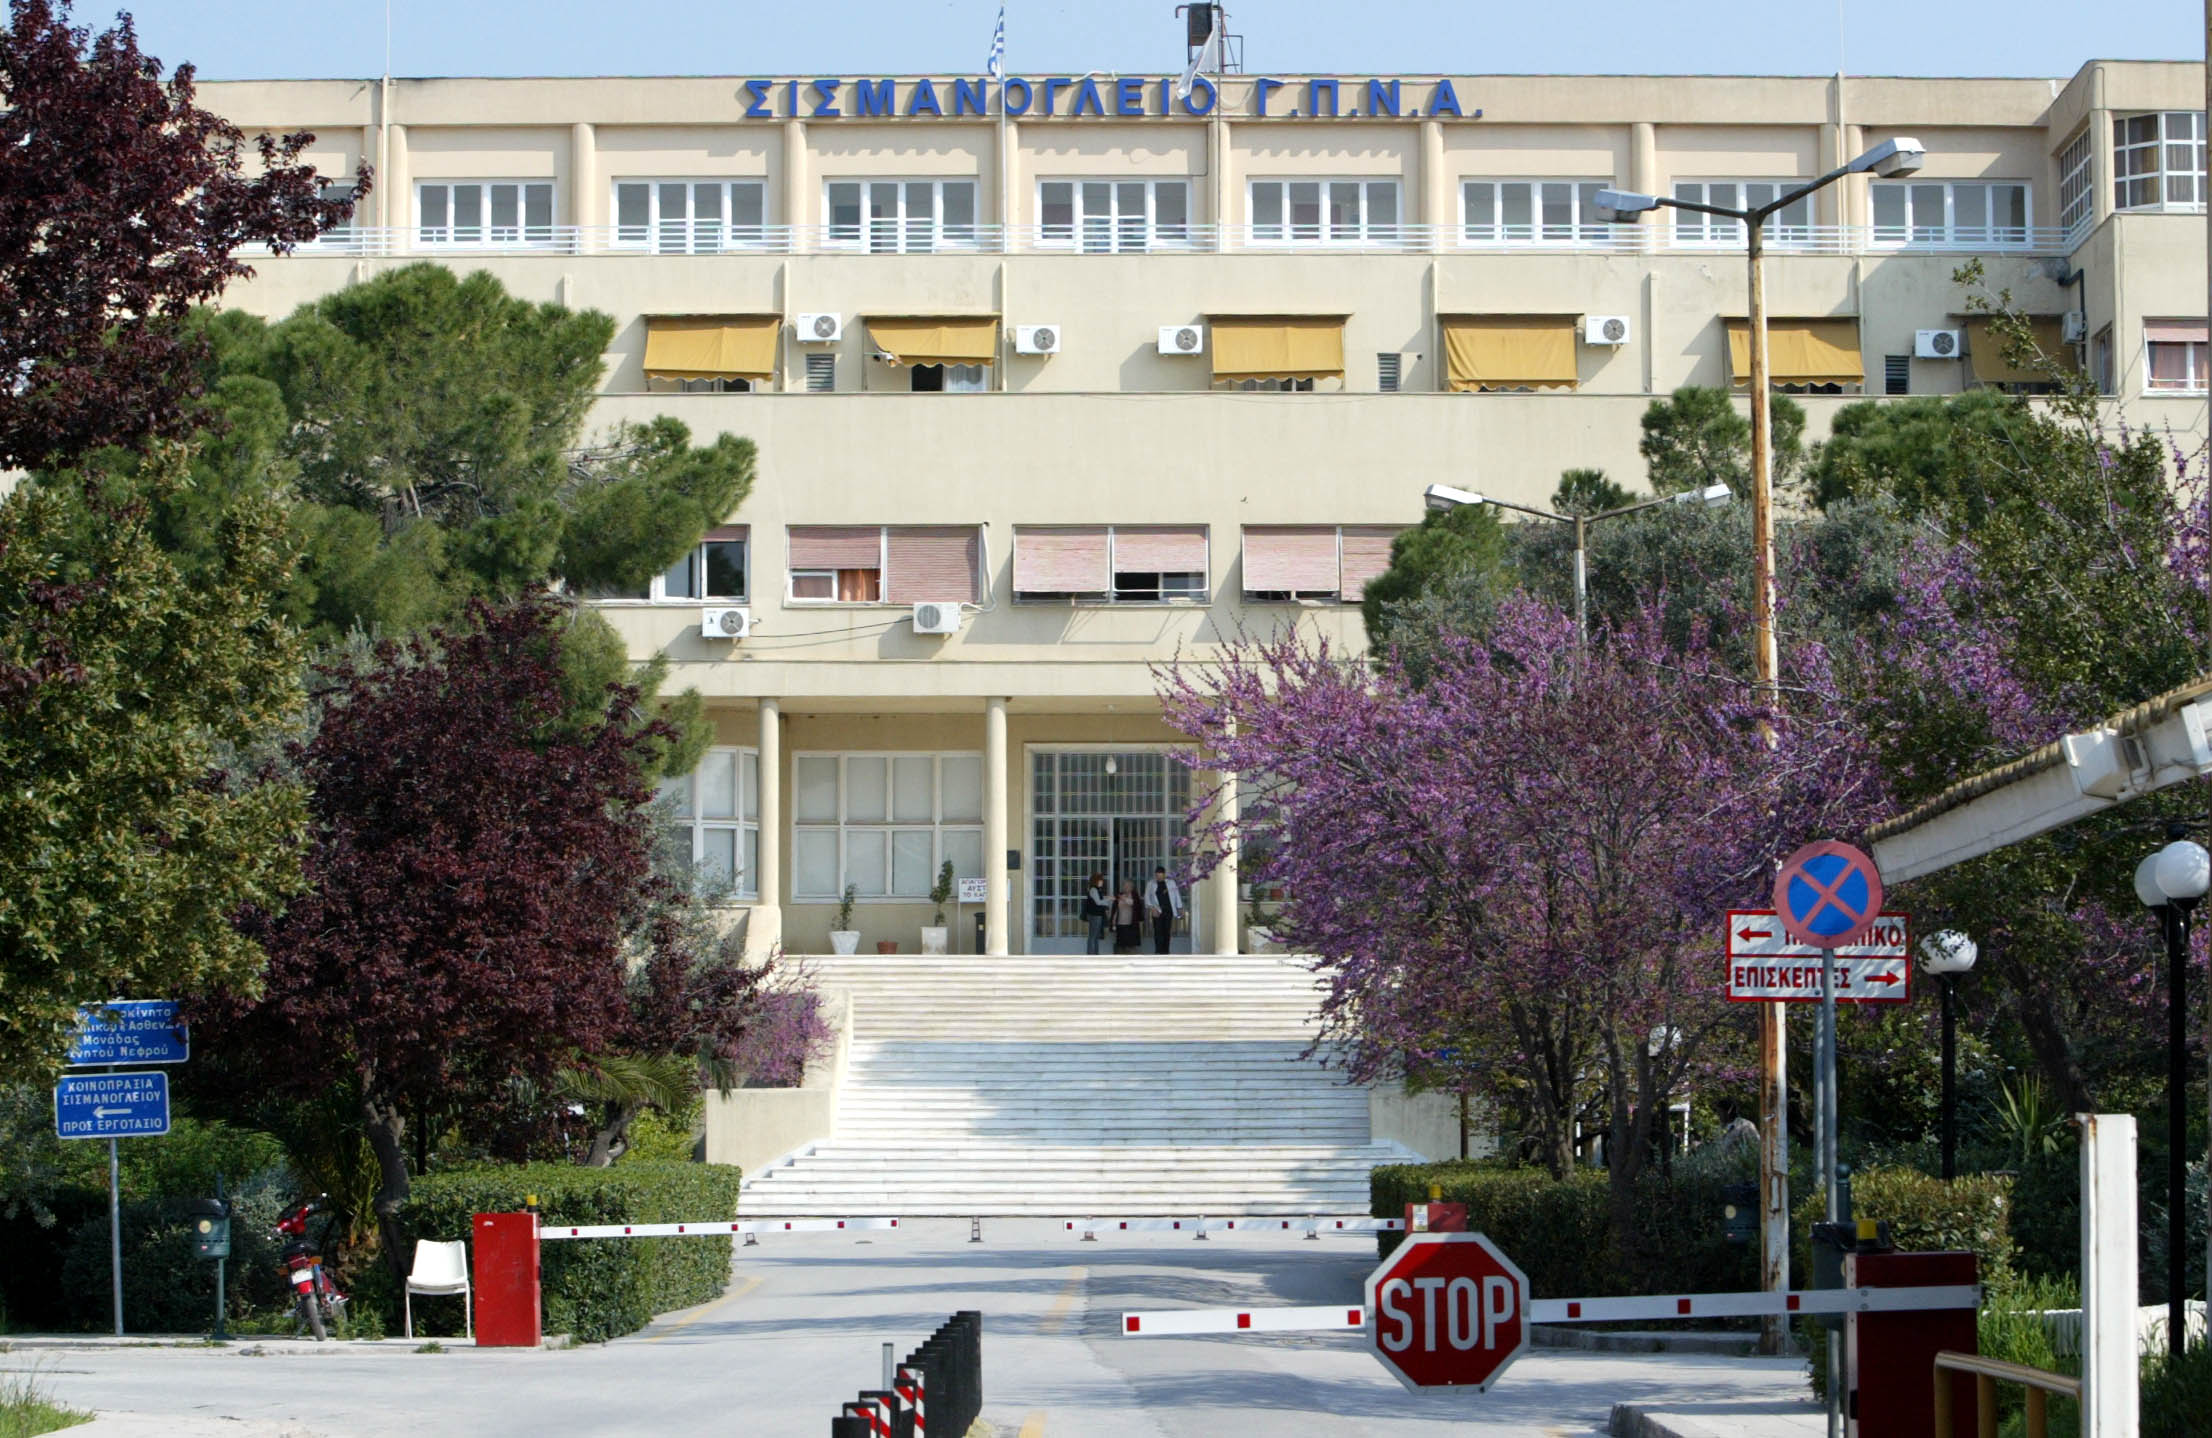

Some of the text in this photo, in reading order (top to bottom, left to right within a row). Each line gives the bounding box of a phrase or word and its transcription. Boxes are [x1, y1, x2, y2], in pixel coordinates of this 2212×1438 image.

[746, 78, 1483, 117] ΣΙΣΜΑΝΟΓΛΕΙΟ Γ.Π.Ν.Α.
[68, 1078, 153, 1092] ΚΟΙΝΟΠΡΑΞΙΑ
[63, 1091, 161, 1105] ΣΙΣΜΑΝΟΓΛΕΙΟΥ
[63, 1117, 162, 1132] ΠΡΟΣ ΕΡΓΟΤΑΞΙΟ
[1380, 1275, 1515, 1352] STOP
